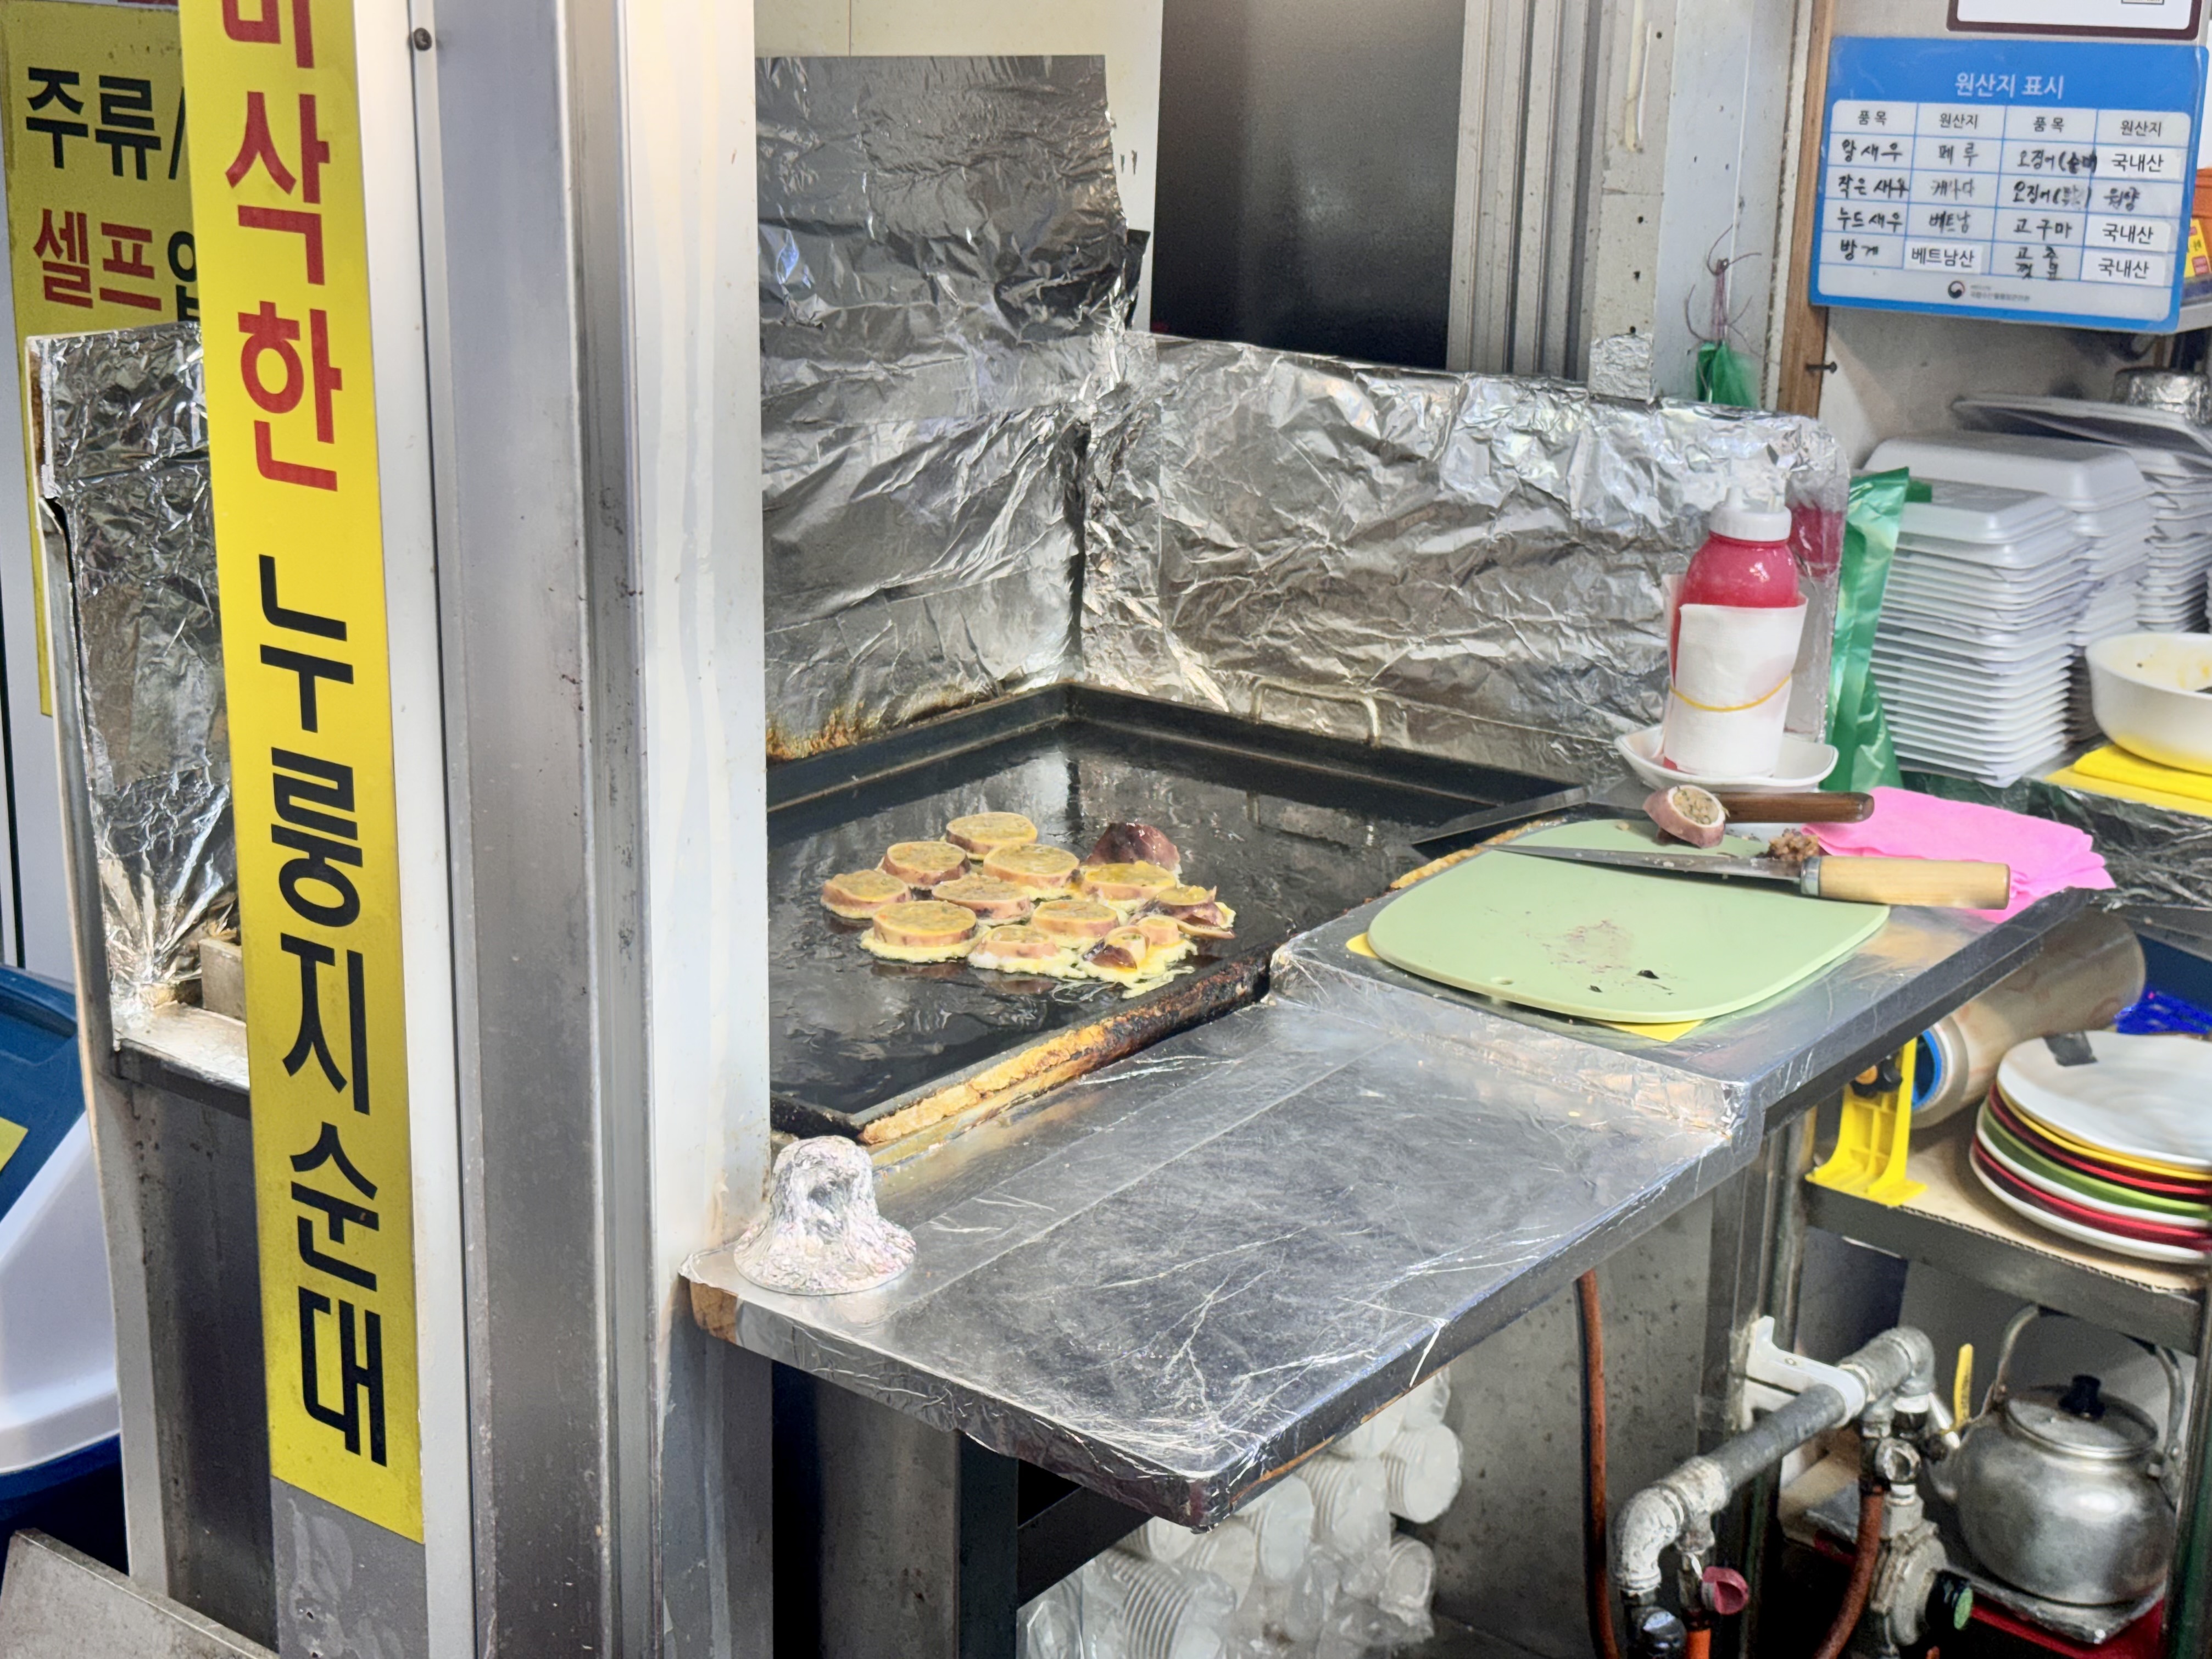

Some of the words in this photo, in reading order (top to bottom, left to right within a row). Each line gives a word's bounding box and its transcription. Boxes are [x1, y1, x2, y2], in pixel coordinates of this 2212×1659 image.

[1955, 71, 2016, 98] 원산지
[2022, 75, 2064, 100] 표시
[1939, 112, 1979, 130] 원산지
[2120, 119, 2163, 137] 원산지
[2111, 153, 2164, 174] 국내산
[2102, 222, 2154, 245] 국내산
[1911, 247, 1975, 268] 베트남산
[2098, 257, 2150, 280] 국내산
[259, 554, 387, 1467] 누룽지순대
